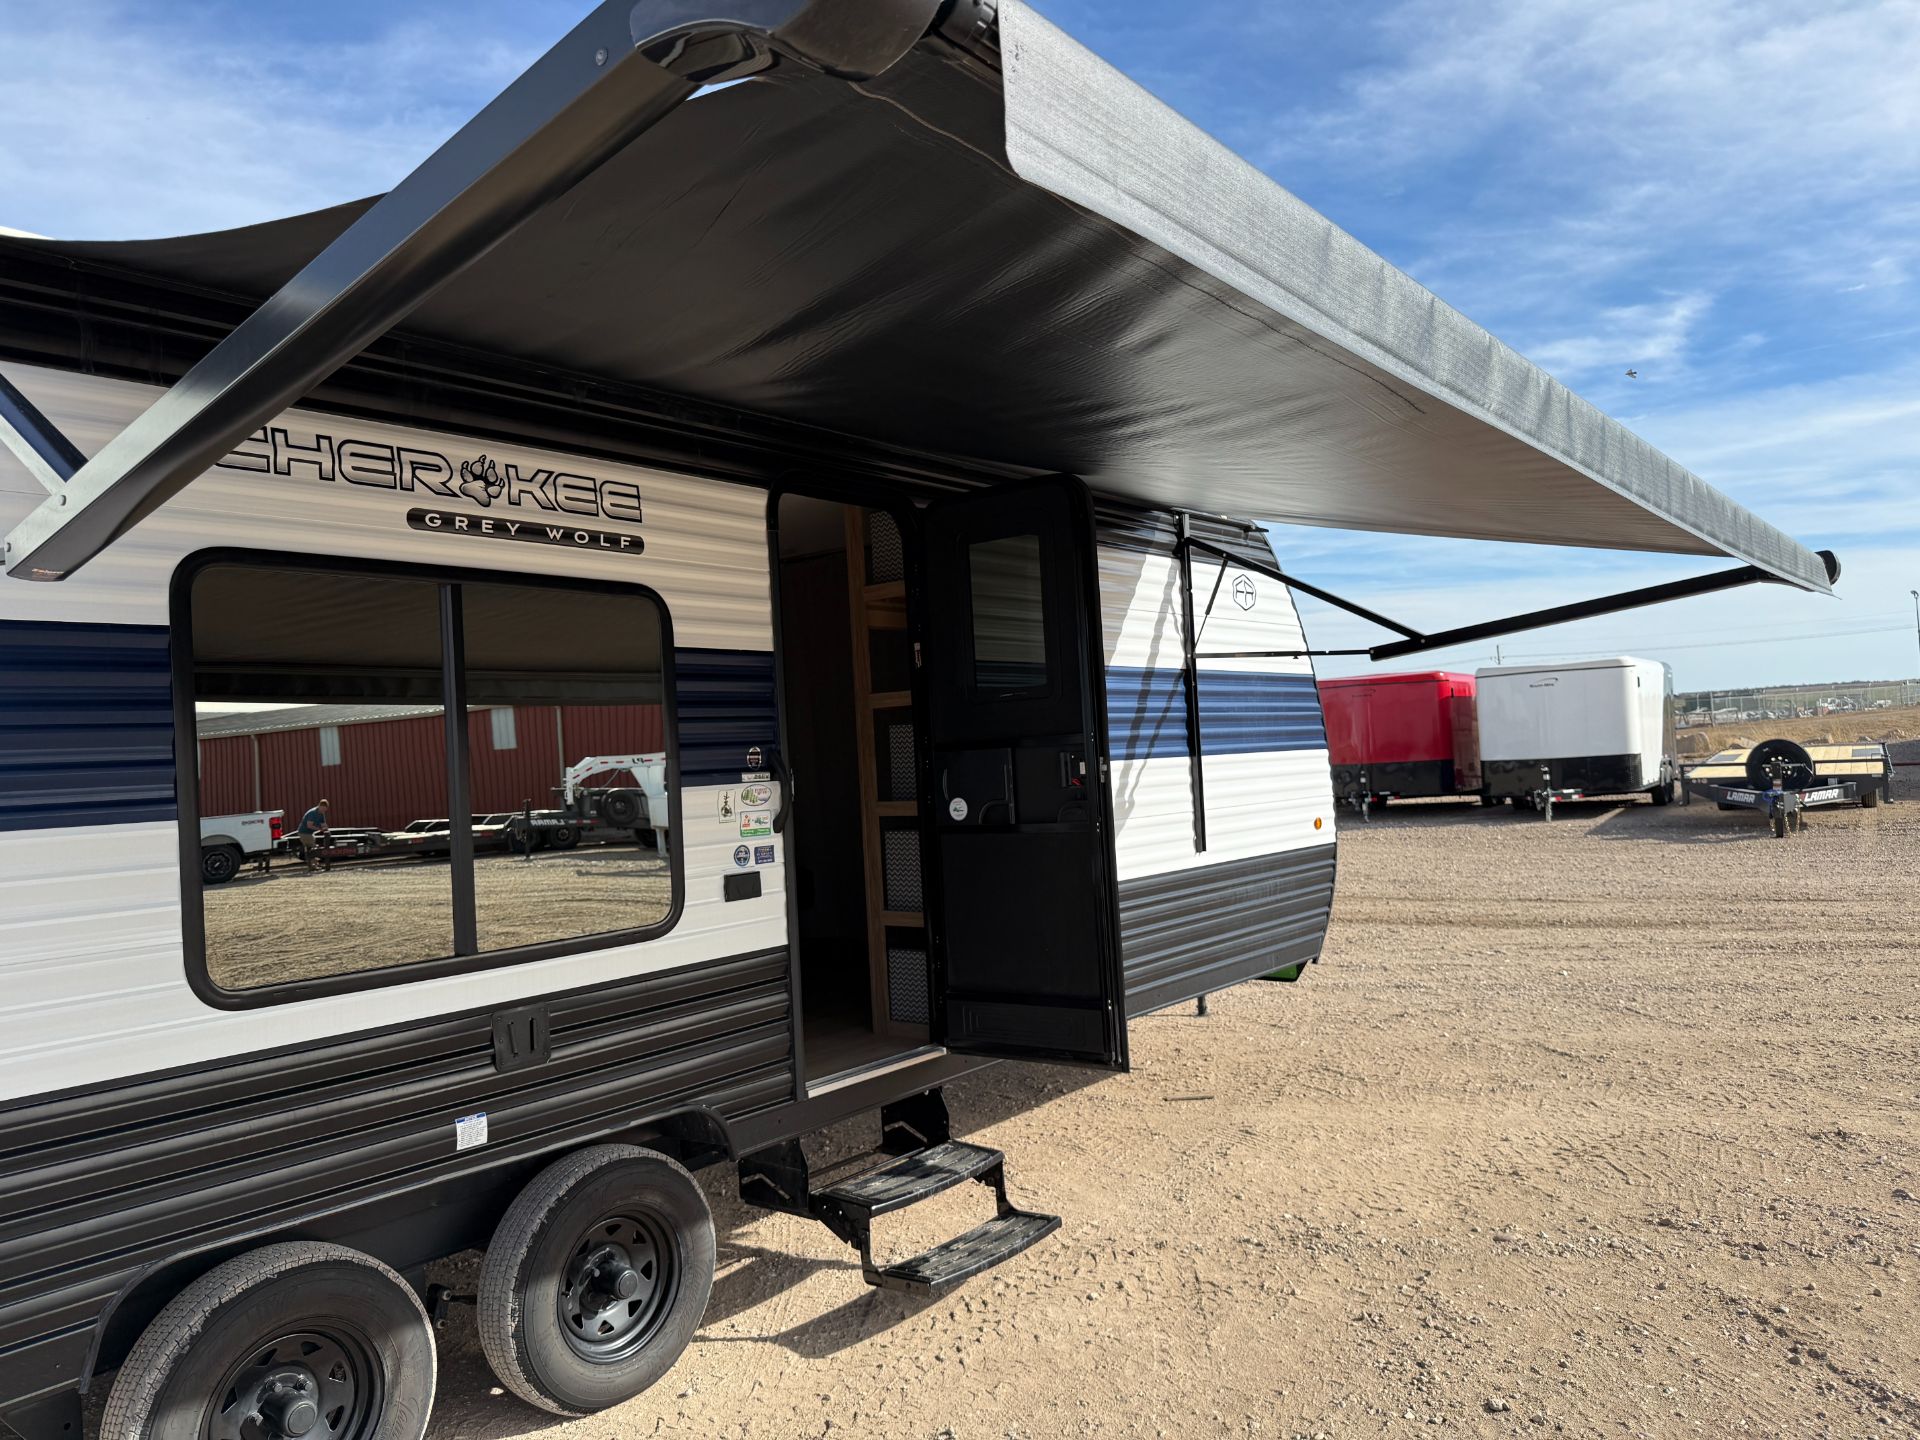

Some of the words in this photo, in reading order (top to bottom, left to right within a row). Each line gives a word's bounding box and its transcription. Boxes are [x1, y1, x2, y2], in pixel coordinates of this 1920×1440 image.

[424, 513, 520, 536] GREY
[546, 527, 632, 549] WOLF
[1727, 791, 1755, 803] LAMAR
[1804, 789, 1838, 802] LAMAR
